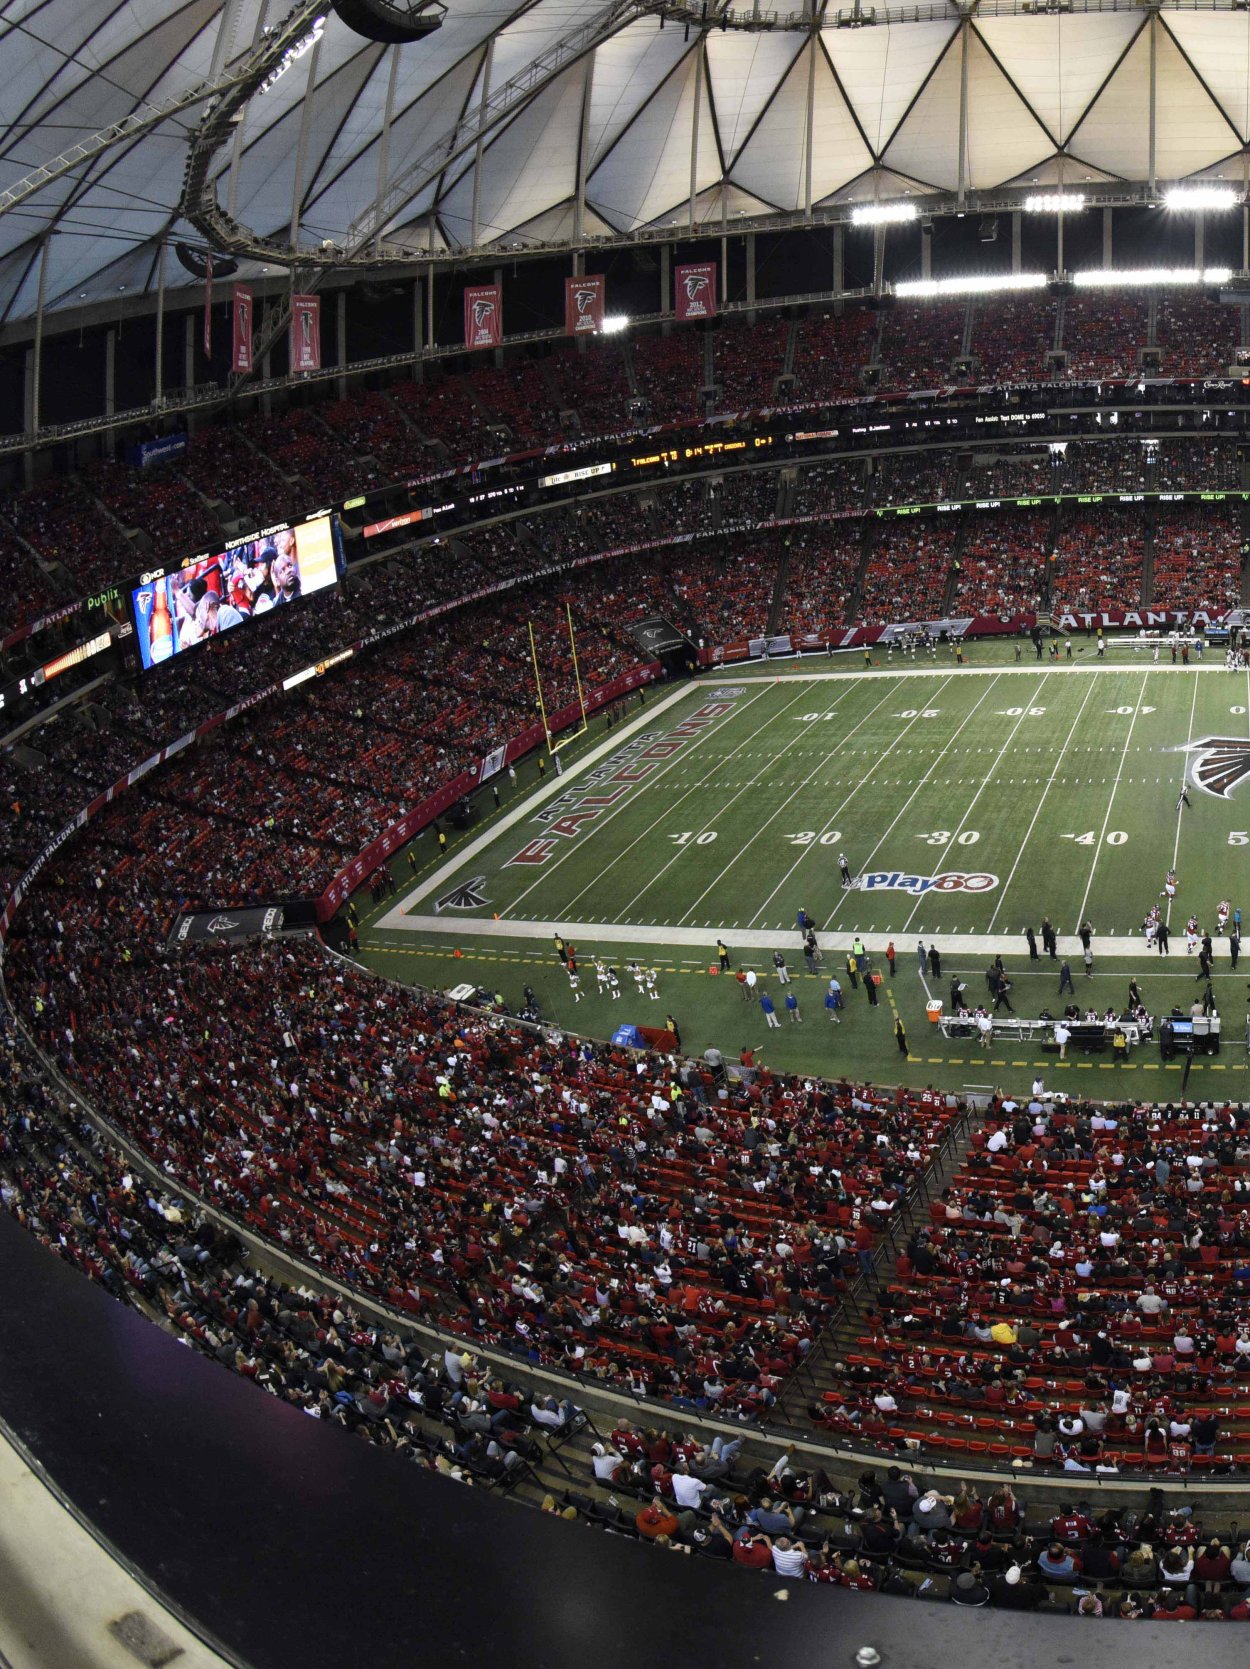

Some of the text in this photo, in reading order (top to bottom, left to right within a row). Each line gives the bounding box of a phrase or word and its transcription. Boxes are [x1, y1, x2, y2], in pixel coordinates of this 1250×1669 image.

[680, 267, 712, 275] FALCONS
[570, 281, 600, 289] FALCONS
[469, 290, 497, 298] FALCONS
[775, 398, 860, 413] ATLANTA FALCONS
[1011, 413, 1024, 421] DOME
[563, 429, 643, 449] ATLANTA FALCONS
[685, 447, 702, 457] 8:14
[407, 473, 441, 487] FALCONS
[391, 517, 411, 528] verizon
[225, 522, 289, 550] NORTHSIDE HOSPITAL
[696, 524, 755, 538] FAN ASSIST!
[150, 568, 165, 580] NCR
[517, 562, 570, 583] FAN ASSIST!
[87, 587, 120, 611] Publix
[1058, 611, 1211, 628] ATLANTA
[364, 620, 412, 645] FAN ASSIST!
[240, 685, 277, 711] ATLANTA
[529, 730, 664, 823] ATLANTA
[500, 702, 737, 870] FALCONS
[672, 831, 718, 845] 10
[791, 830, 842, 845] 20
[927, 830, 980, 846] 30
[1074, 830, 1129, 845] 40
[22, 824, 75, 890] ATLANTA FALCONS
[177, 915, 195, 941] GEICO
